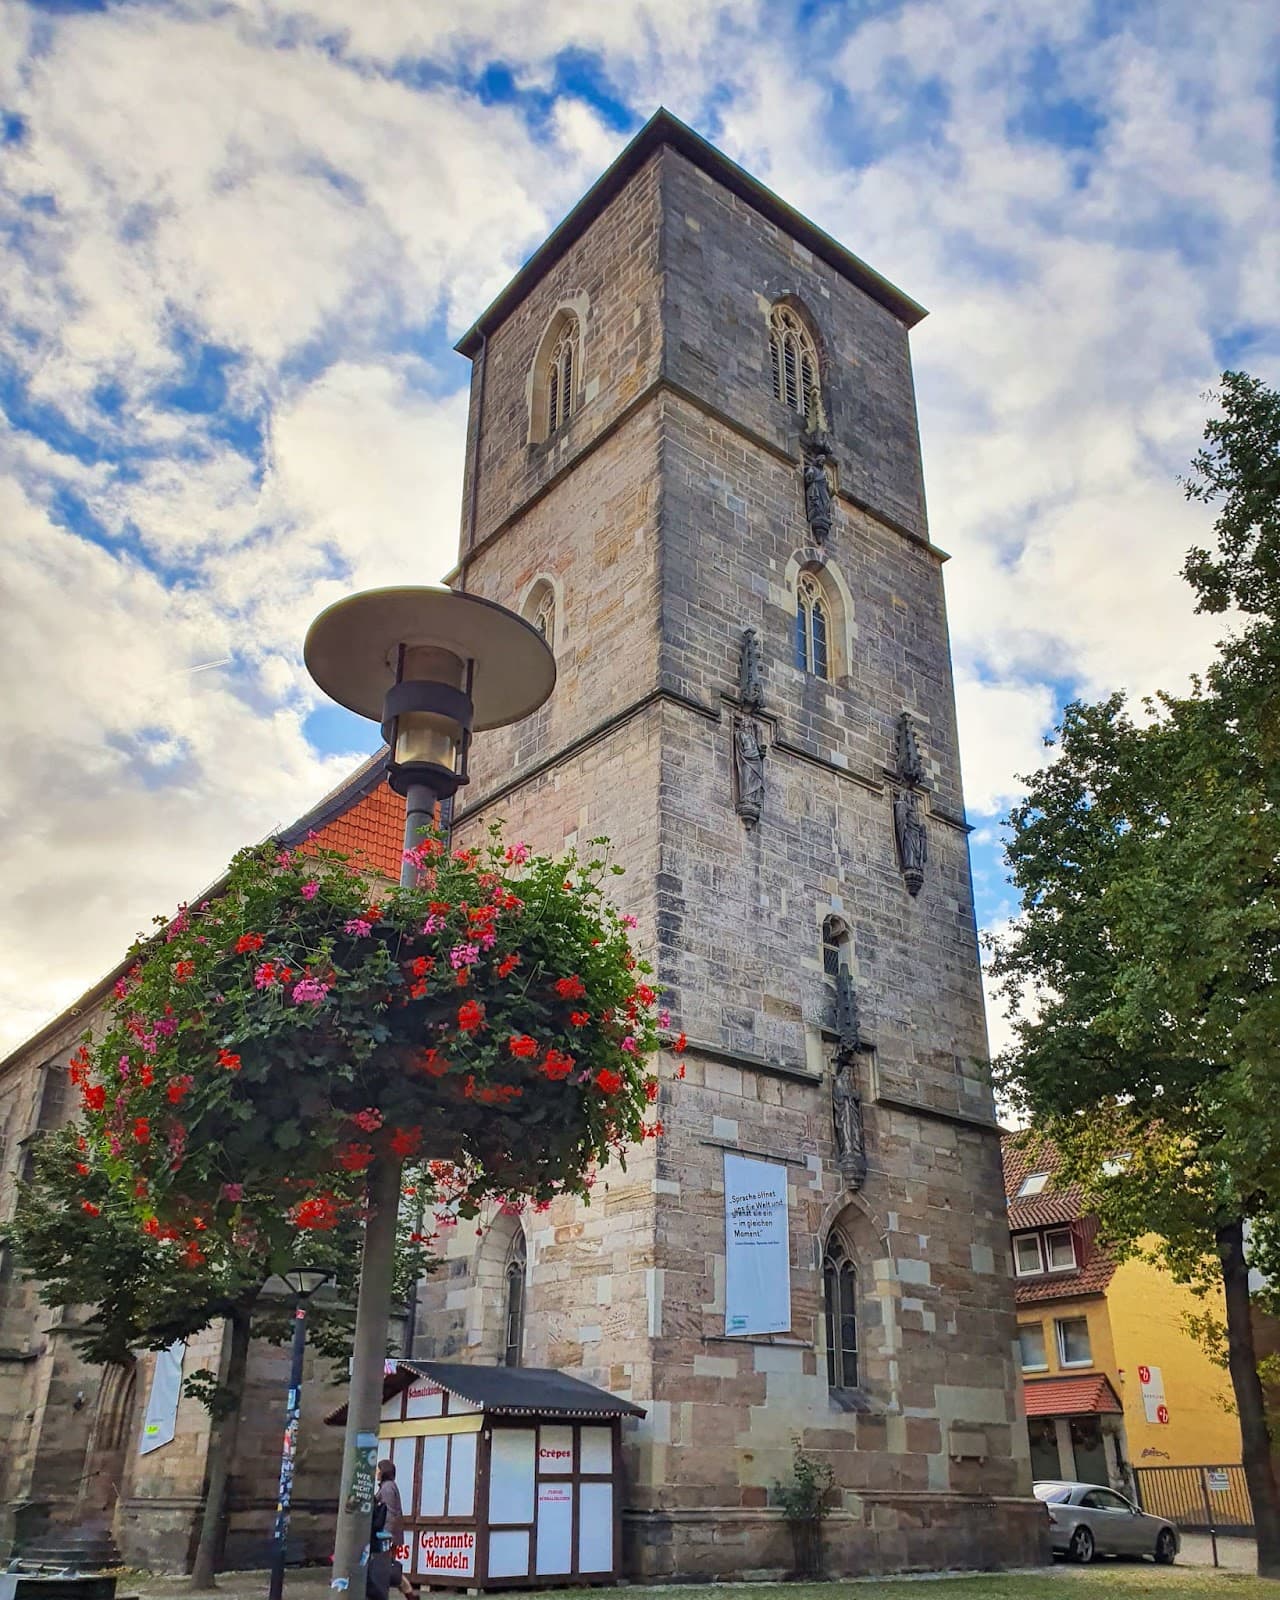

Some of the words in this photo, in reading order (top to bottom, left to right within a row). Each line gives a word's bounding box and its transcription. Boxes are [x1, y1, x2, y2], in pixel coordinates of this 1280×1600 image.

[755, 1201, 770, 1209] Welt
[747, 1219, 773, 1229] gleichen
[421, 1531, 474, 1548] Gebrannte
[426, 1550, 469, 1569] Mandeln
